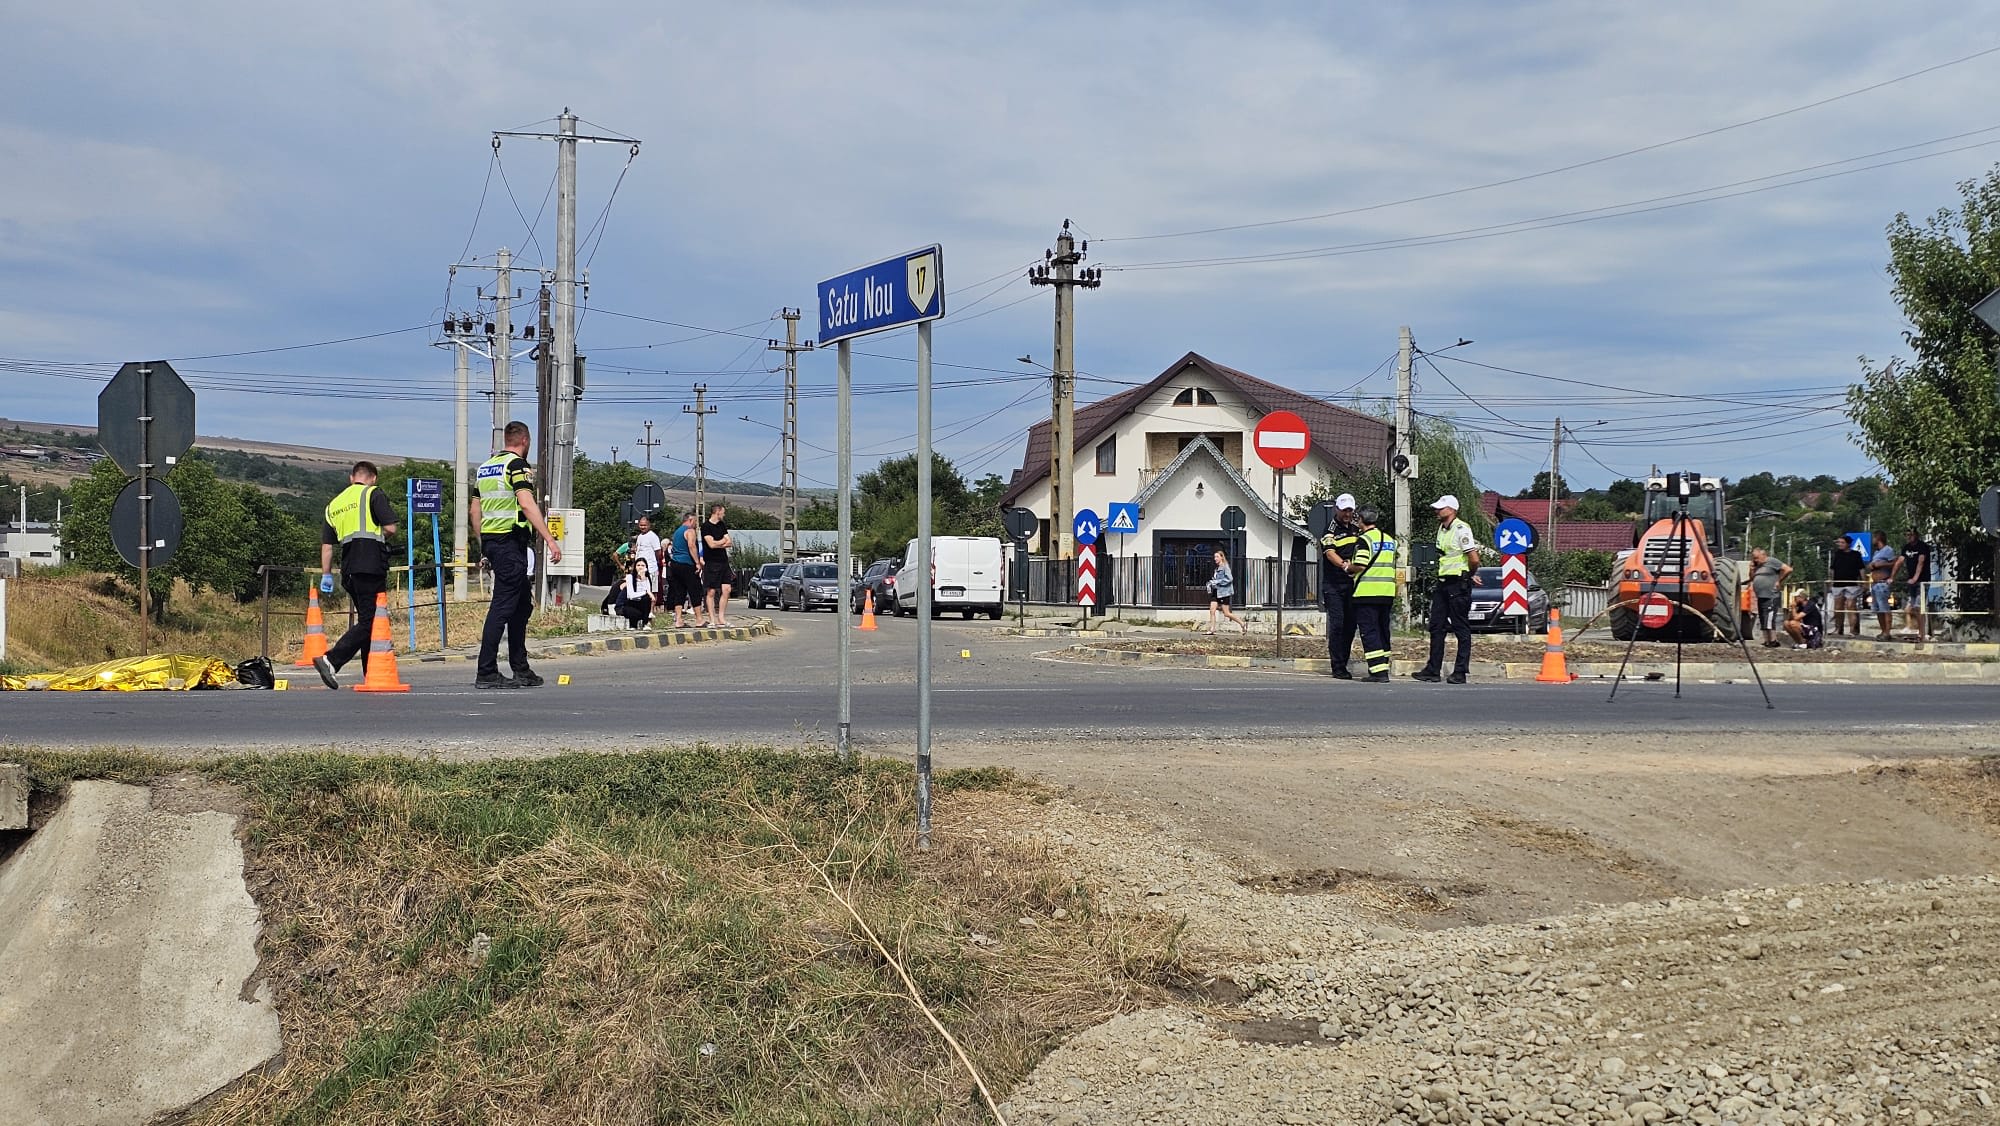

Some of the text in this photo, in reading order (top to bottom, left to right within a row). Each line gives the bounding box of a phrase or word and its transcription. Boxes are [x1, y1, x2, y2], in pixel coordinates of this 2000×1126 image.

[916, 266, 926, 295] 17
[828, 275, 893, 329] Satu Nou
